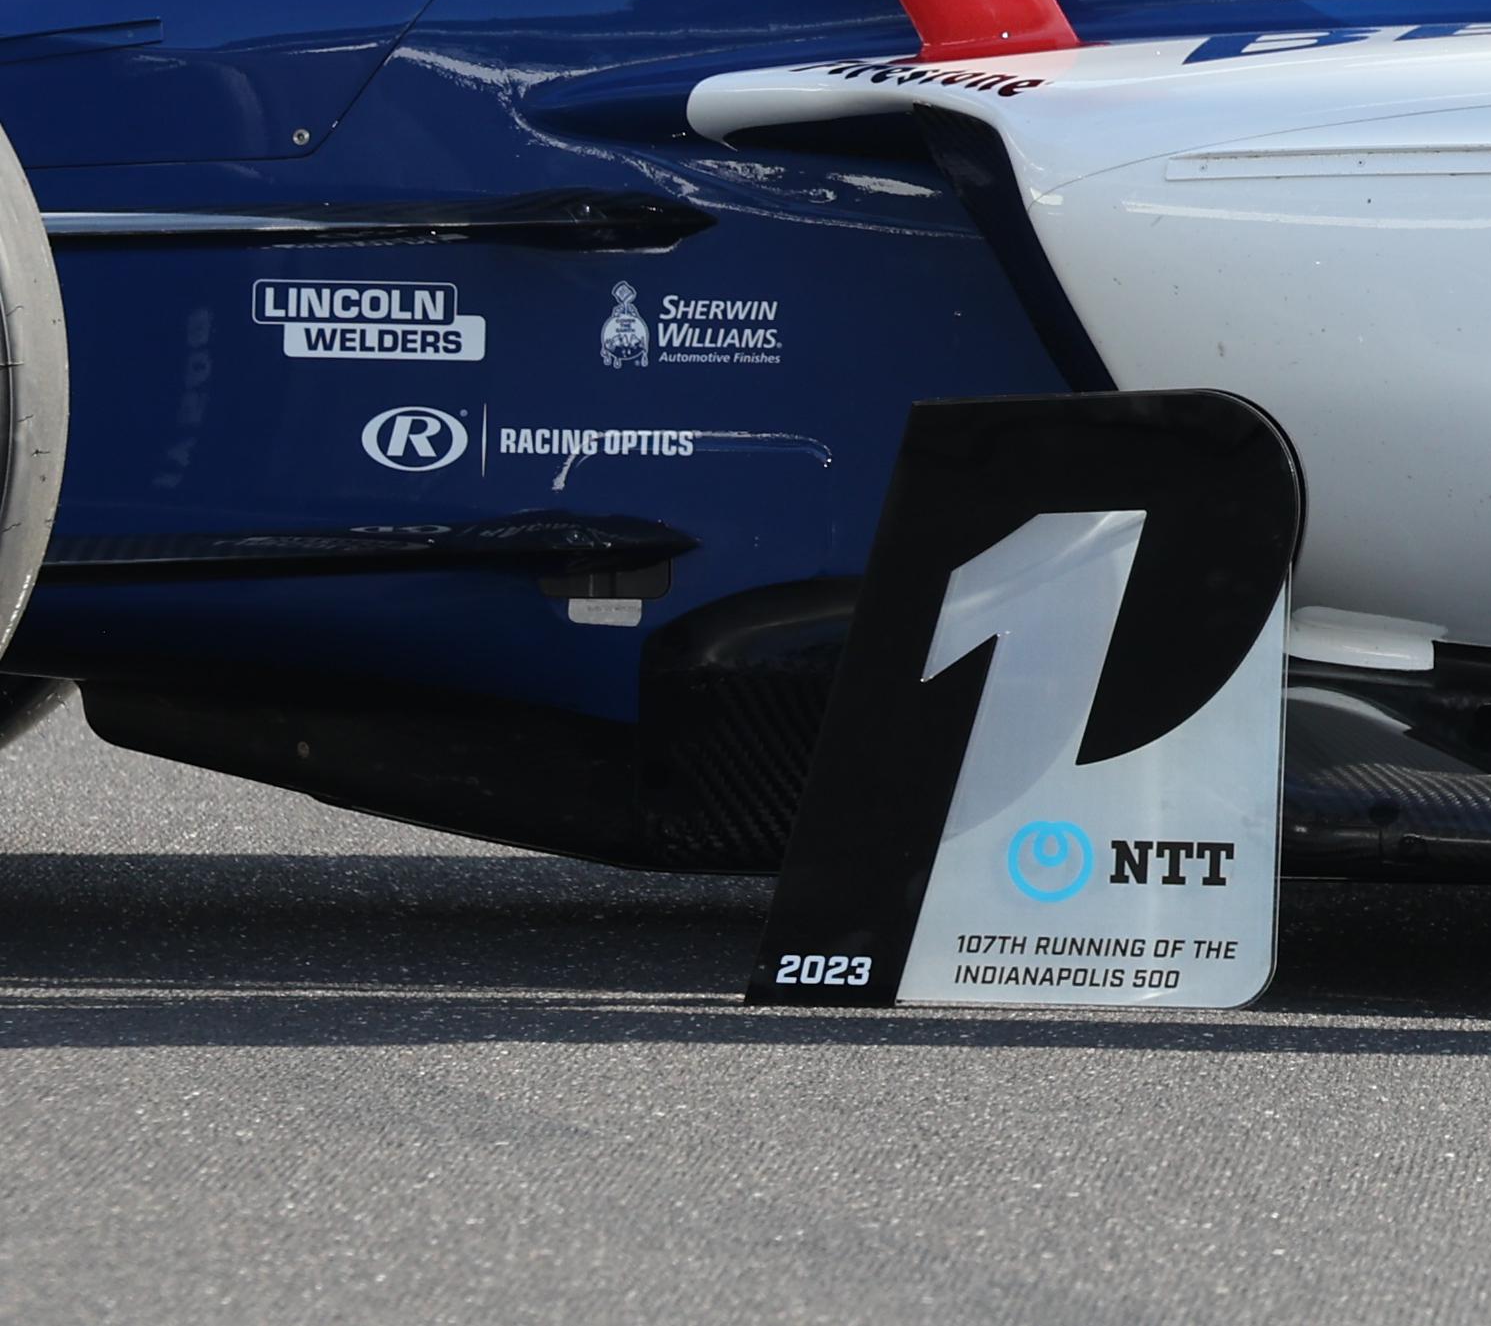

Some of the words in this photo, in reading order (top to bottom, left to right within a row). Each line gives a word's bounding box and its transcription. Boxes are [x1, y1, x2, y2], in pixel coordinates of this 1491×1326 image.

[264, 287, 446, 323] LINCOLN
[303, 326, 463, 356] WELDERS
[658, 351, 731, 364] Automotive
[733, 352, 781, 364] Finishes
[500, 429, 598, 456] RACING
[603, 429, 694, 456] OPTICS
[1110, 839, 1235, 887] NTT
[956, 934, 1027, 957] 107TH
[1034, 935, 1146, 958] RUNNING
[1153, 937, 1186, 959] OF
[1193, 939, 1239, 960] THE
[776, 954, 872, 986] 2023
[954, 965, 1125, 989] INDIANAPOLIS
[1131, 968, 1180, 990] 500
